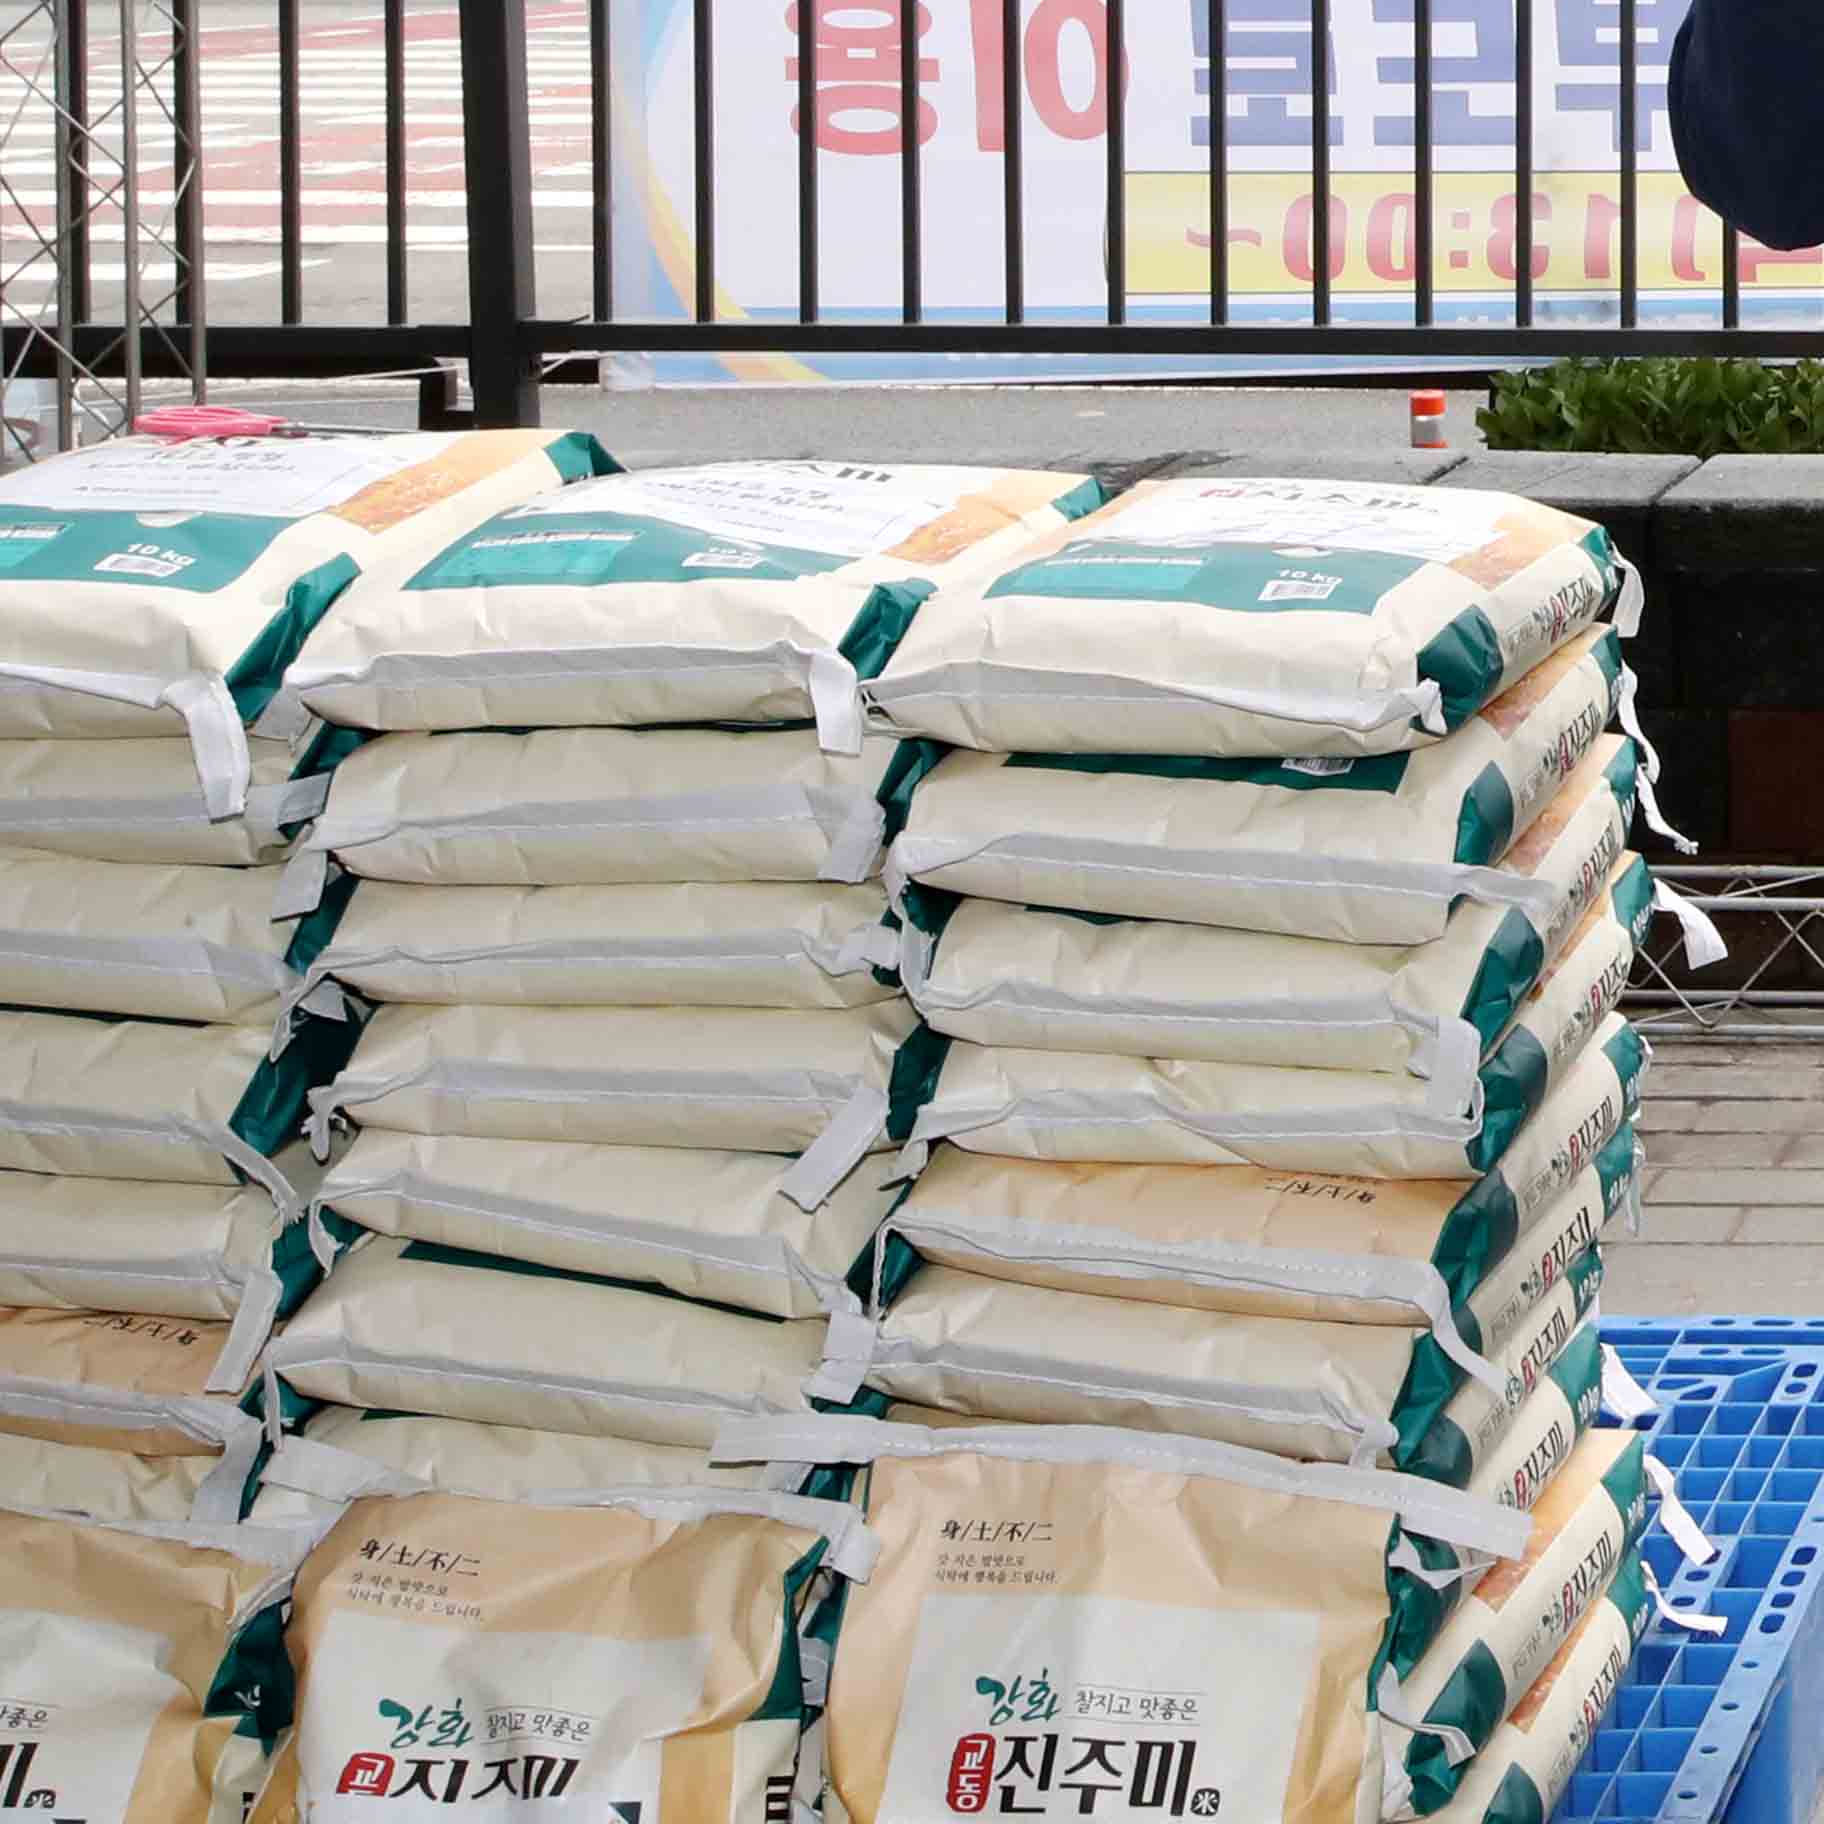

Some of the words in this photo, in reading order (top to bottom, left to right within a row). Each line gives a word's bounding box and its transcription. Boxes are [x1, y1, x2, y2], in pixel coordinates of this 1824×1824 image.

[359, 1537, 481, 1577] 身/土/不/二
[939, 1519, 1054, 1544] 身/土/不/二
[976, 1667, 1063, 1726] 강화
[1075, 1689, 1132, 1715] 찰지고
[1139, 1694, 1199, 1721] 맛좋은
[378, 1697, 475, 1750] 강화
[531, 1713, 591, 1743] 맛좋은
[954, 1737, 990, 1810] 교동
[993, 1732, 1198, 1818] 진주미
